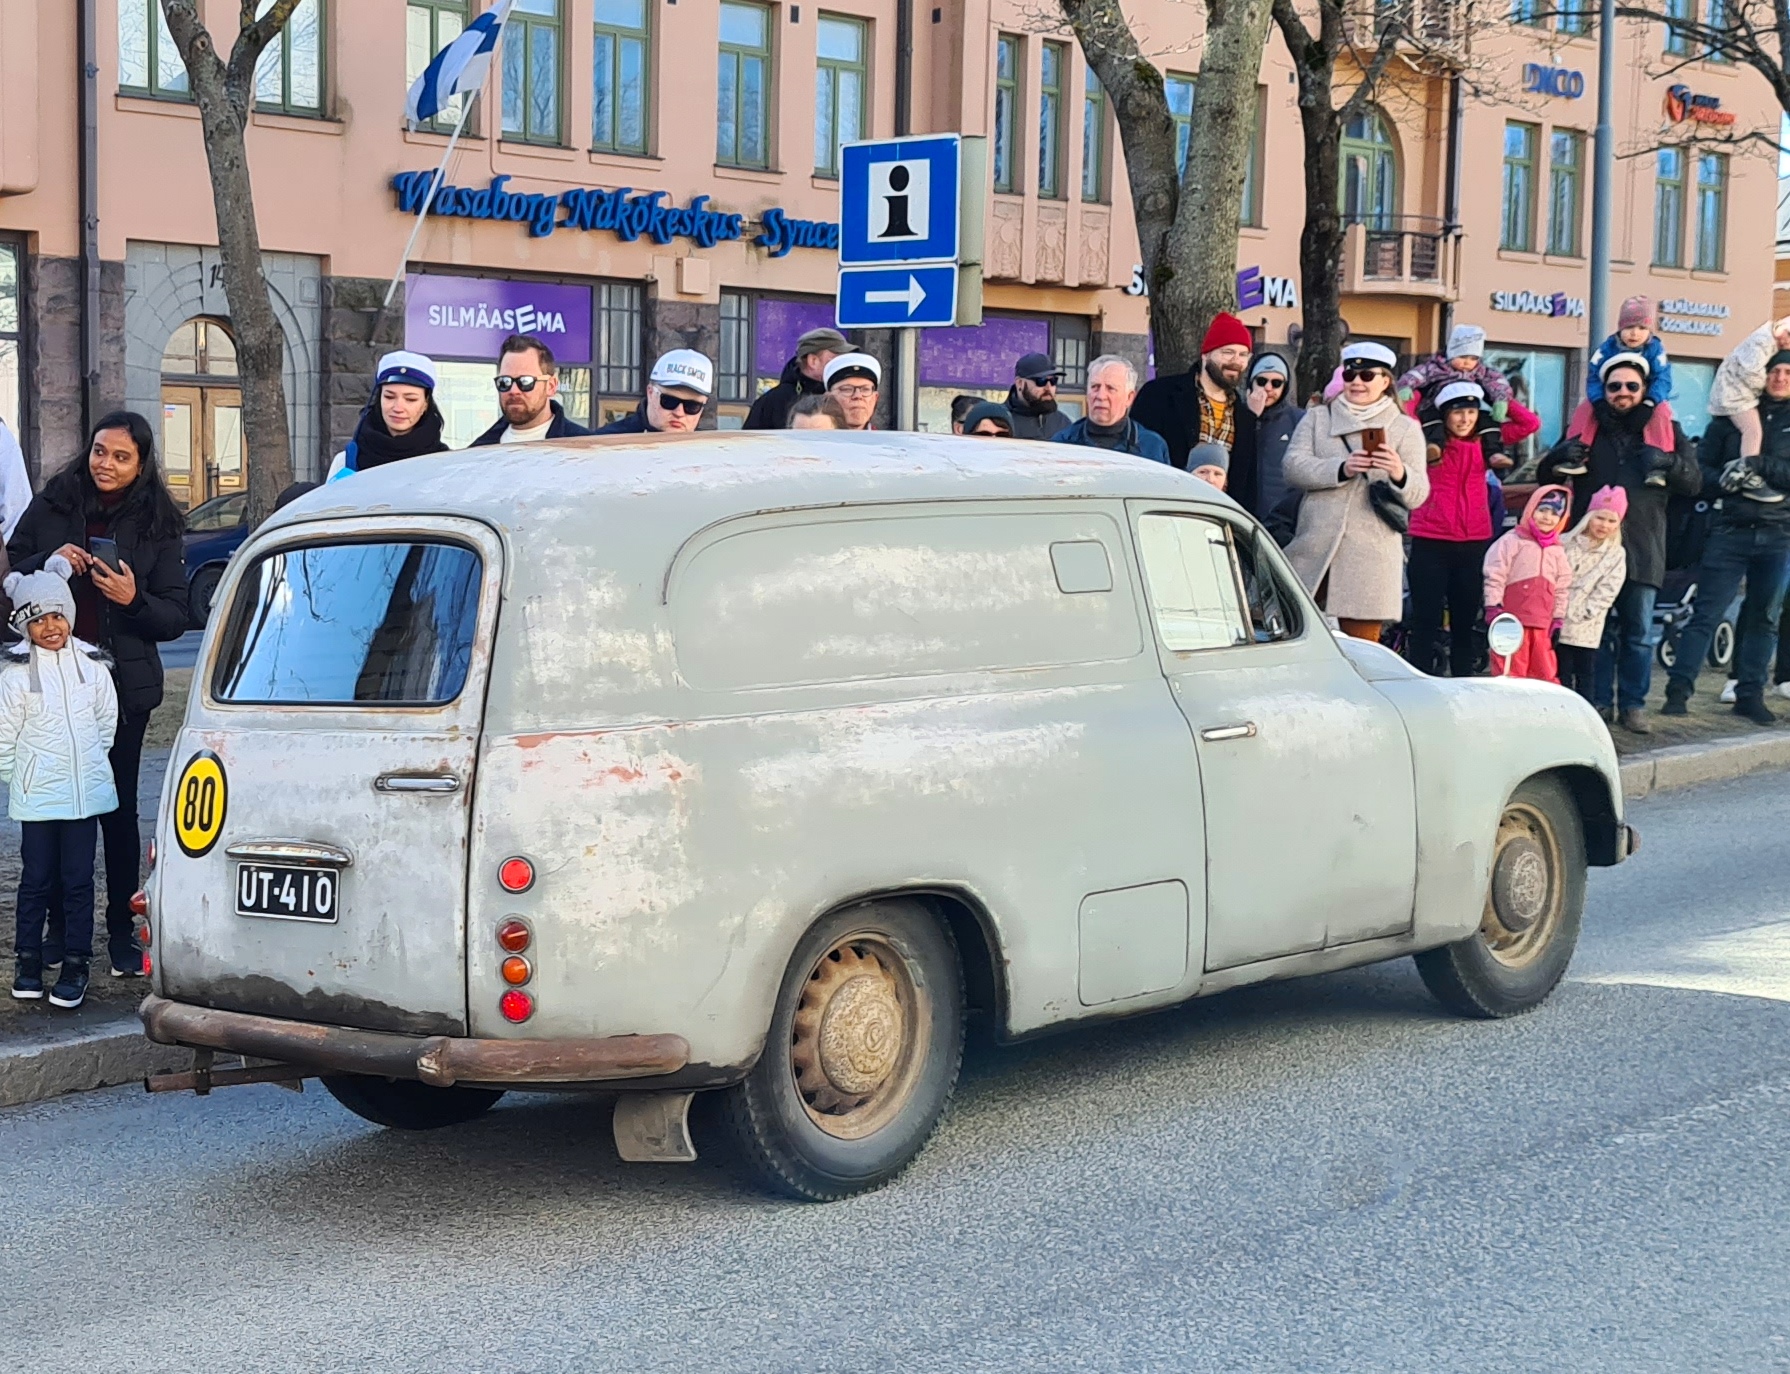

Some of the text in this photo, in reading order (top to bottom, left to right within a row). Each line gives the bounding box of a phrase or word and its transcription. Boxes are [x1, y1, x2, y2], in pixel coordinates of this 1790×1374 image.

[393, 168, 558, 237] Wasaborg
[557, 186, 743, 248] Näkökeskus
[428, 303, 566, 335] SILMÄASEMA
[1492, 290, 1585, 318] SILMÄASEMA
[666, 363, 687, 375] BLACK
[184, 776, 216, 832] 80
[241, 870, 333, 914] UT-410
